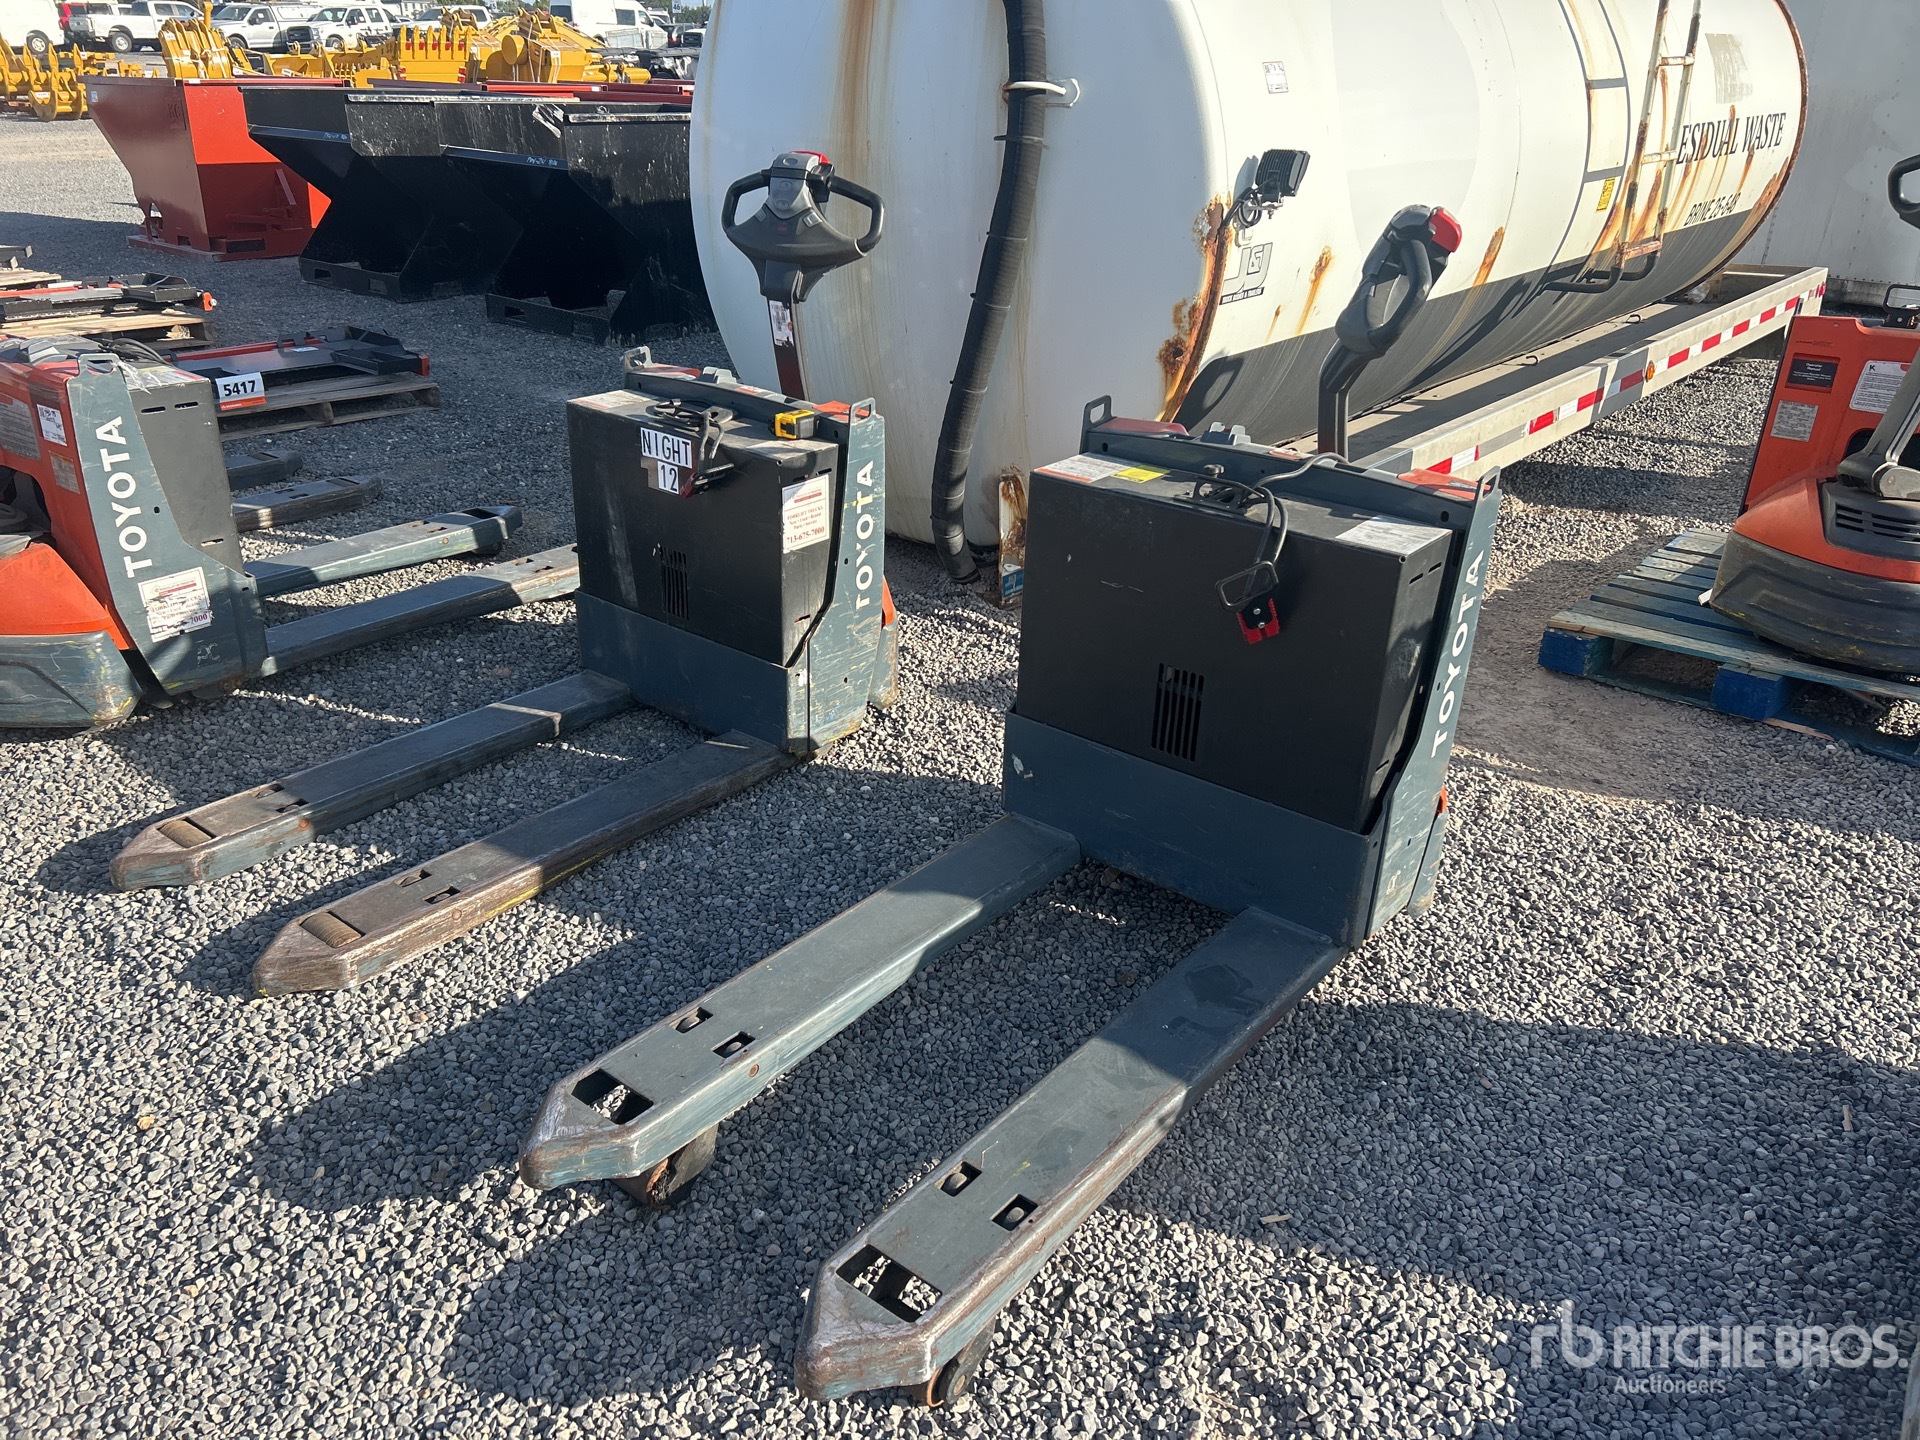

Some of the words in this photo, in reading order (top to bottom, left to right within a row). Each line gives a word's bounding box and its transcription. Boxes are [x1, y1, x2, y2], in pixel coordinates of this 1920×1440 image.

[1676, 118, 1740, 165] ESIDUAL
[1742, 112, 1786, 153] WASTE
[223, 380, 256, 397] 5417
[642, 430, 690, 466] NIGHT
[95, 416, 153, 579] TOYOTA
[660, 464, 678, 492] 12
[786, 526, 825, 545] 713-675-7000
[856, 460, 874, 610] TOYOTA
[1431, 550, 1485, 759] TOYOTA
